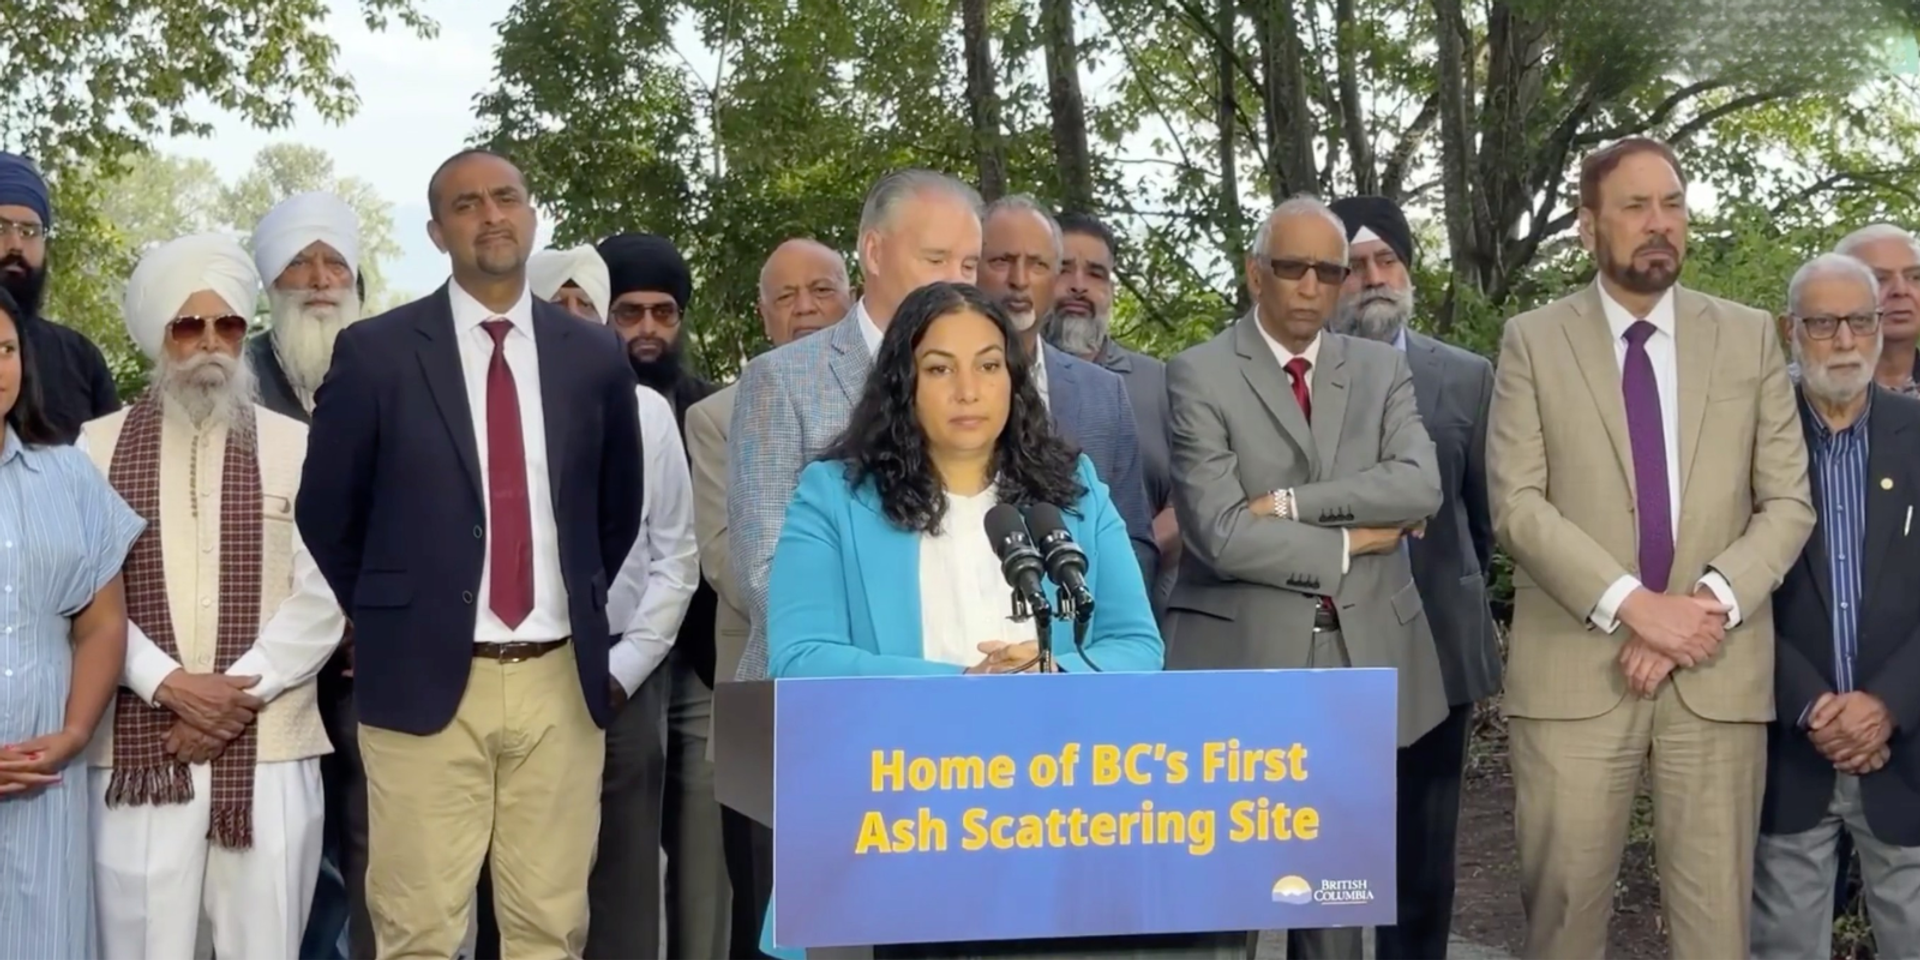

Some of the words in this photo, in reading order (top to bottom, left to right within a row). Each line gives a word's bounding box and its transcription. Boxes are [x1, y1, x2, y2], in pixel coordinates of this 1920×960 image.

[870, 749, 1014, 791] Home
[1029, 743, 1080, 787] of
[1203, 739, 1308, 782] First
[855, 809, 947, 854] Ash
[961, 801, 1215, 855] Scattering
[1229, 798, 1319, 841] Site
[1313, 889, 1374, 902] COLUMBIA
[1321, 879, 1367, 891] BRITISH
